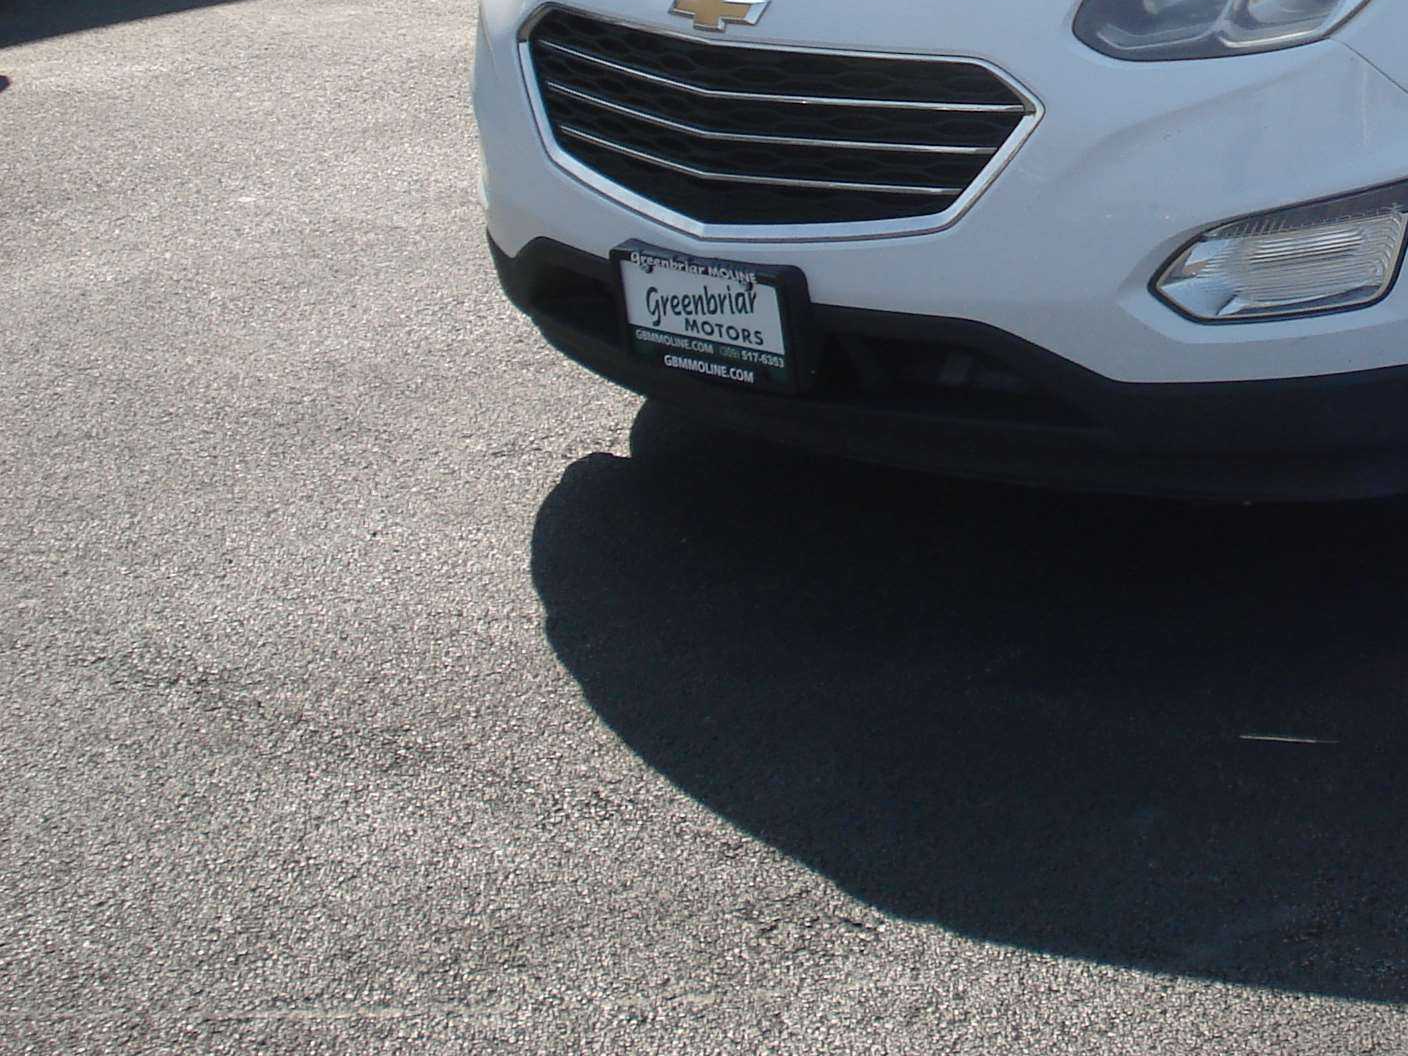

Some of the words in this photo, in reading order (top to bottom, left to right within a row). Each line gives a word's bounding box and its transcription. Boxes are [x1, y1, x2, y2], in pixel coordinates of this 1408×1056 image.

[630, 251, 705, 275] Greenbriar
[708, 266, 758, 284] MOLINE
[646, 285, 756, 327] Greenbriar
[635, 329, 714, 355] GBMMOLINE.COM
[684, 317, 764, 346] MOTORS
[664, 354, 754, 384] GBMMOLINE.COM
